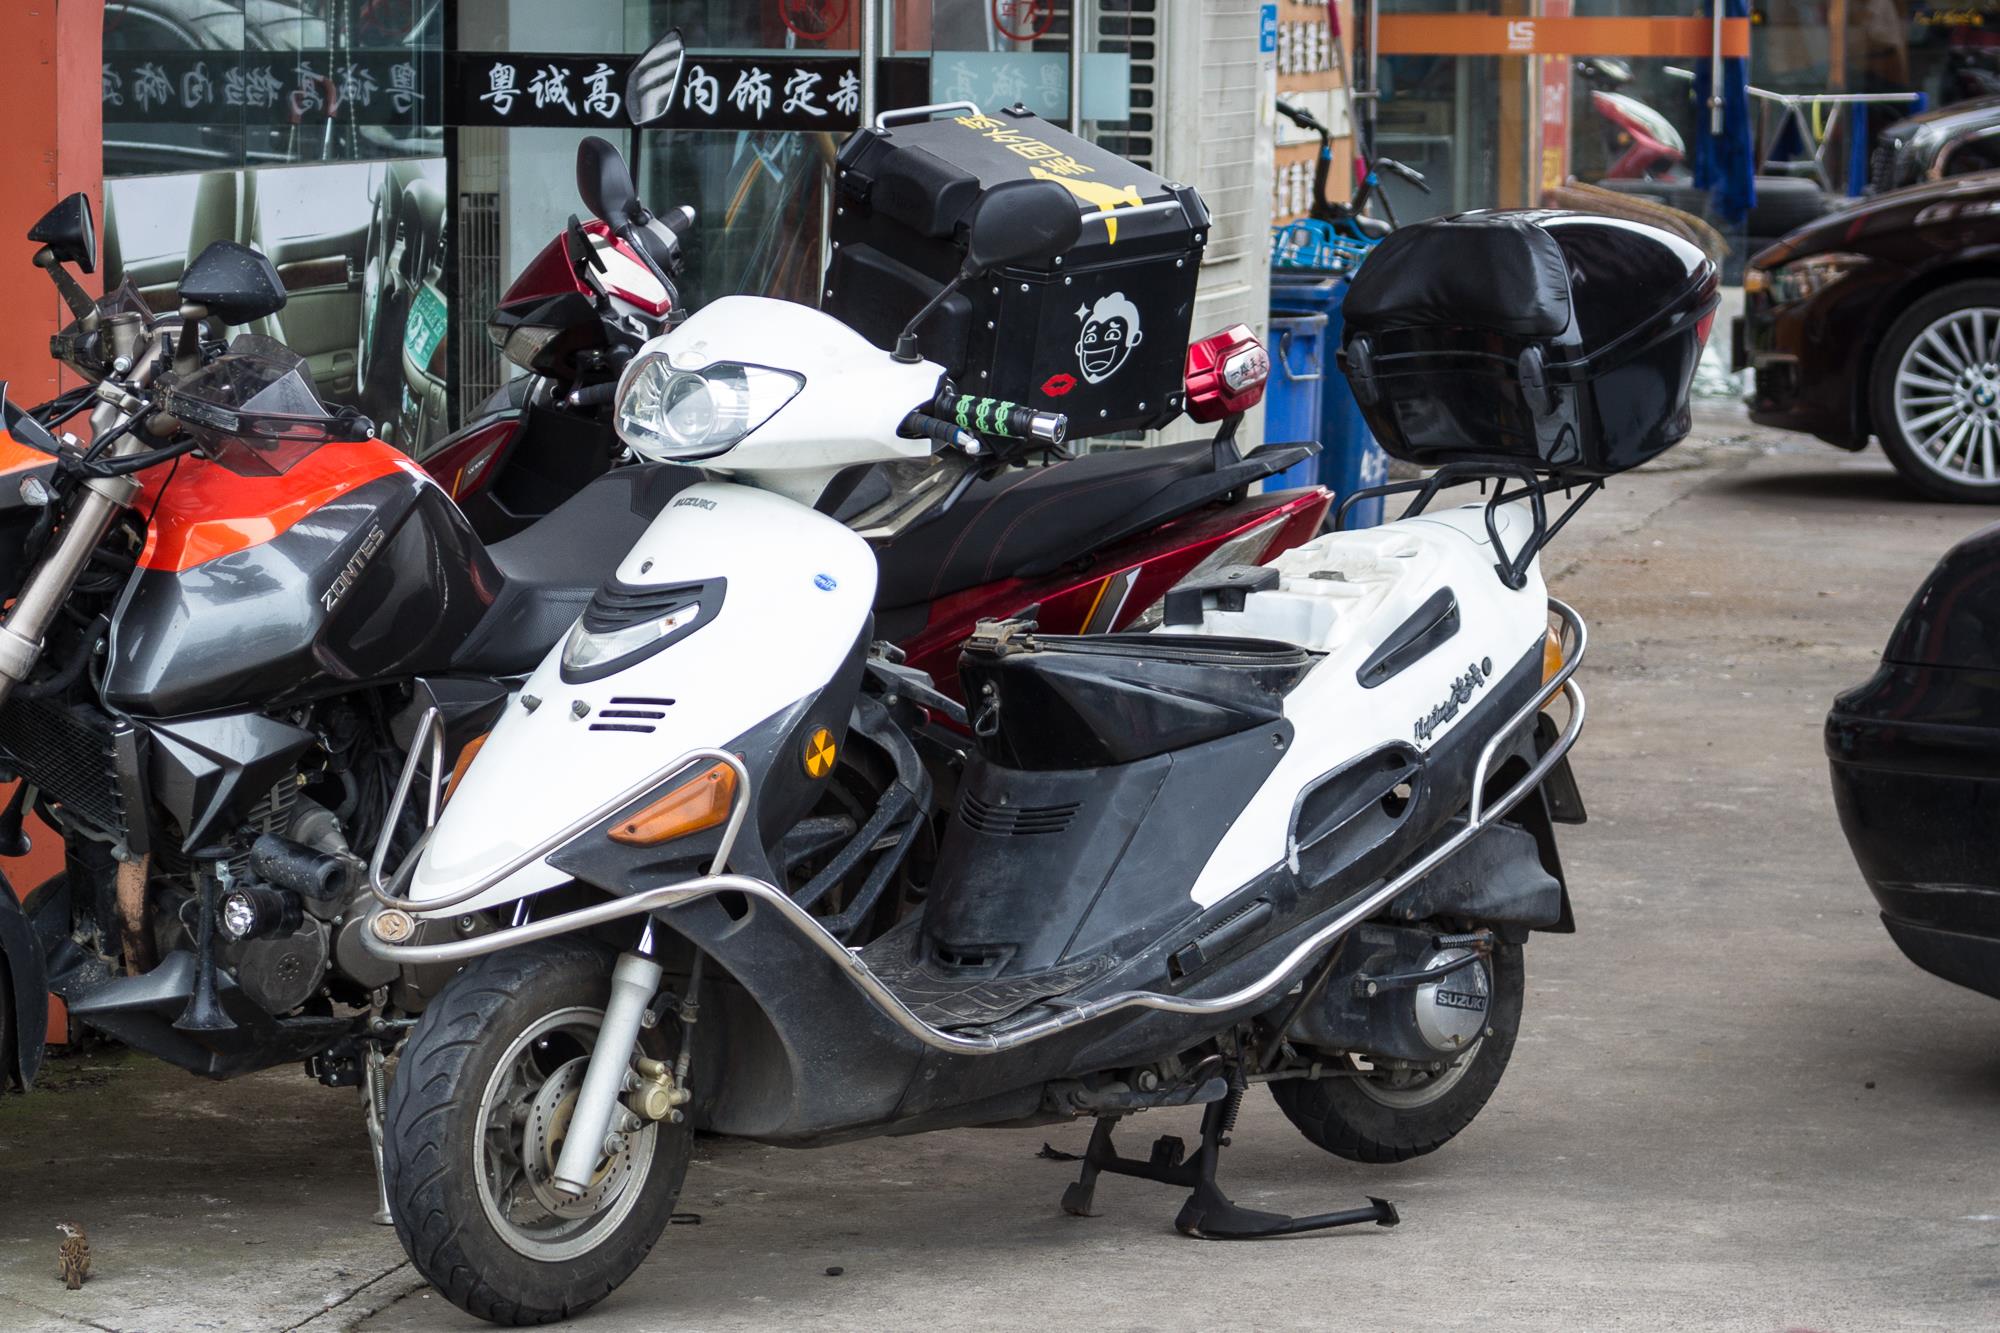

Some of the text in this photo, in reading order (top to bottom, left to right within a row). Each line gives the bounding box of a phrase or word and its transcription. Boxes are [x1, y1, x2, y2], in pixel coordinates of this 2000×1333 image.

[954, 114, 1096, 176] 美团外卖
[673, 497, 718, 511] SUZUKI
[320, 524, 386, 613] ZONTES
[1438, 992, 1486, 1010] SUZUKI
